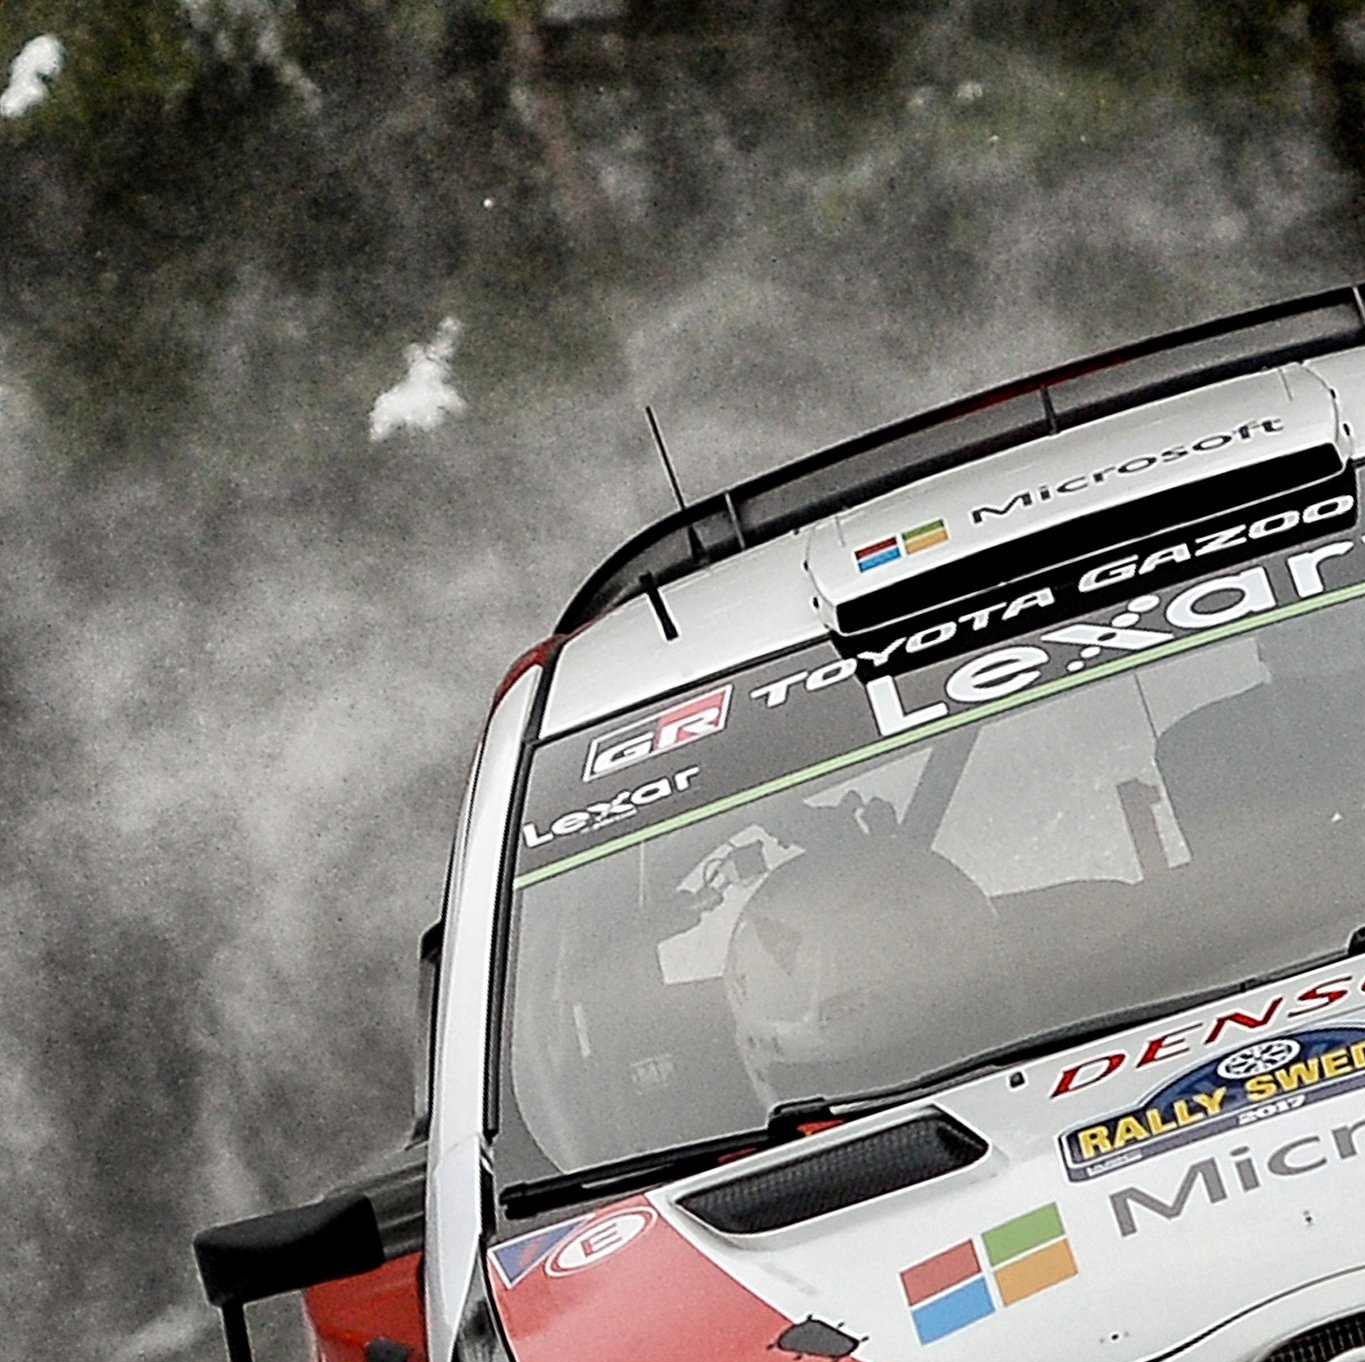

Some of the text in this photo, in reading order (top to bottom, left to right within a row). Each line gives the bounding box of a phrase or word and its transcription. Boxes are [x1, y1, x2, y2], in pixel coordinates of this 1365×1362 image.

[971, 417, 1285, 525] Microsoft
[750, 586, 1055, 708] TOYOTA
[1078, 493, 1355, 594] GAZOO
[865, 540, 1354, 737] Lexar
[592, 706, 720, 776] GR
[522, 766, 700, 849] Lexar
[1077, 1086, 1228, 1160] RALLY
[1238, 1094, 1306, 1125] 2017
